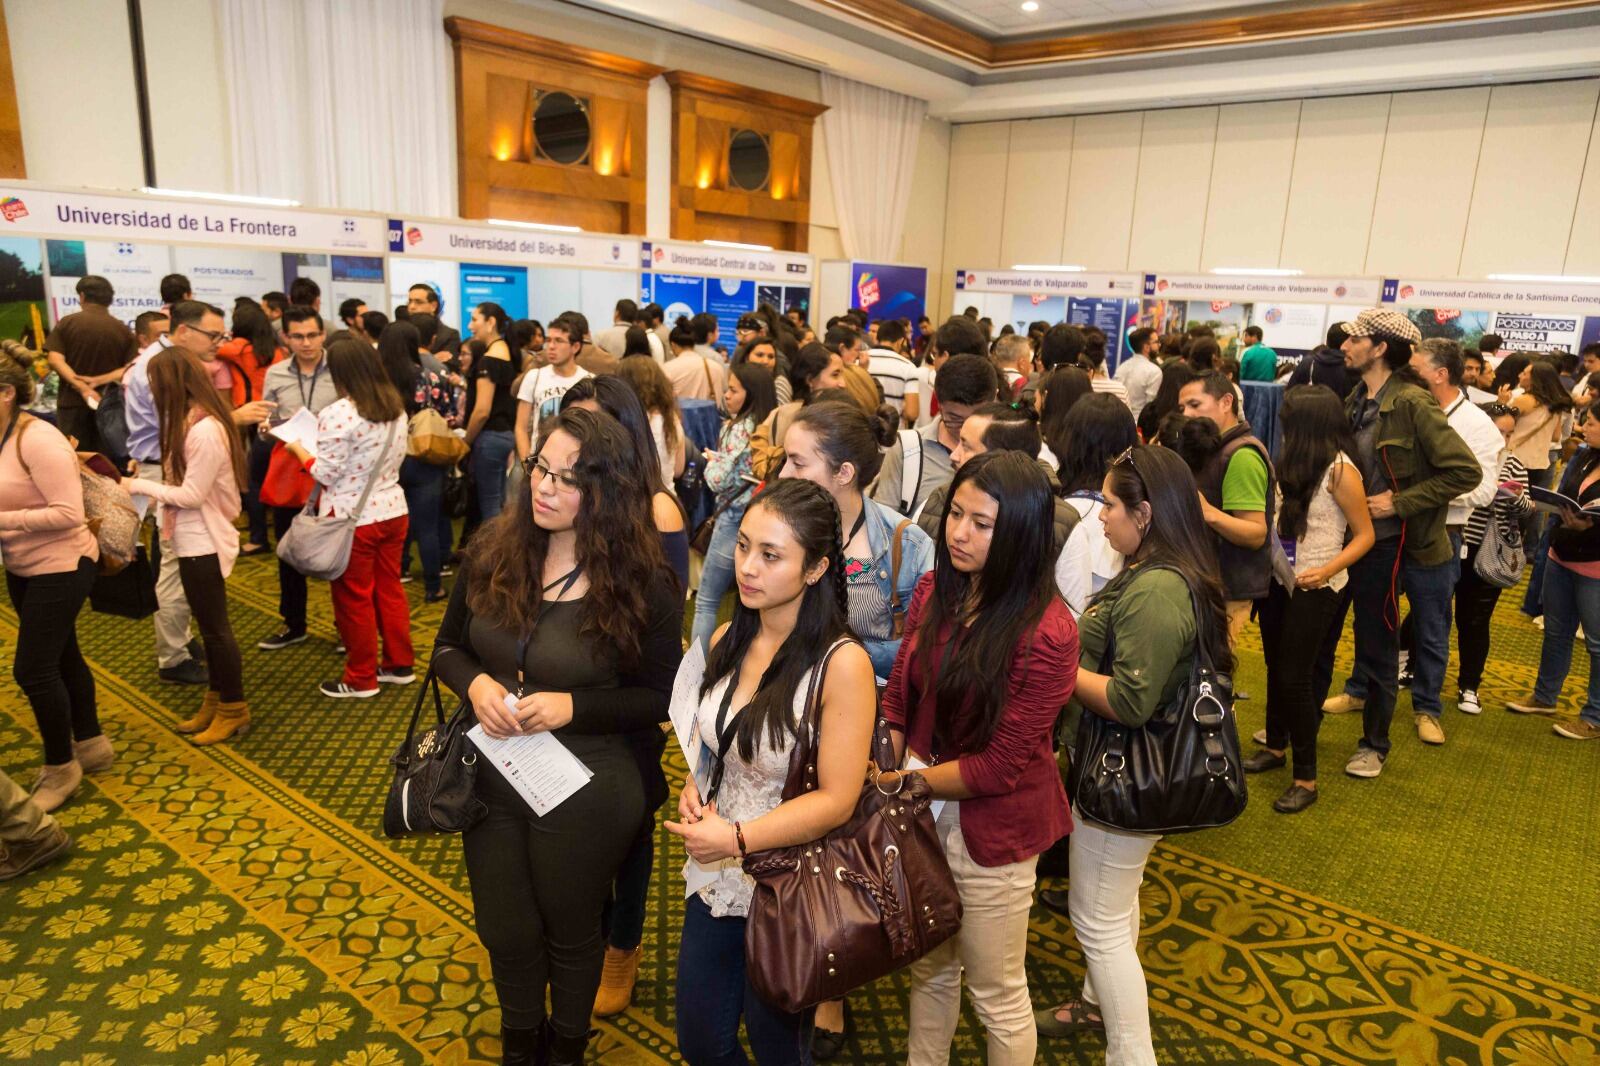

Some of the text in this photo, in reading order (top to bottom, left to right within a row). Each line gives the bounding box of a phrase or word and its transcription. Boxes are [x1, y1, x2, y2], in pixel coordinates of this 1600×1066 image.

[57, 205, 297, 237] Universidad de La Frontera
[449, 234, 517, 252] Universidad
[520, 240, 535, 253] del
[671, 253, 776, 272] Universidad Central de Chile
[193, 267, 254, 276] POSTGRADOS
[986, 277, 1032, 288] Universidad
[1033, 279, 1044, 288] de
[1145, 282, 1155, 290] 10
[1171, 282, 1203, 290] Pontificia
[1204, 282, 1245, 292] Universidad
[1277, 284, 1286, 292] de
[1384, 286, 1395, 297] 11
[1419, 289, 1466, 299] Universidad
[1503, 292, 1514, 300] de
[1437, 310, 1461, 321] Chile
[1497, 319, 1574, 331] POSTGRADOS
[1510, 331, 1536, 341] PASO
[1538, 333, 1545, 341] A
